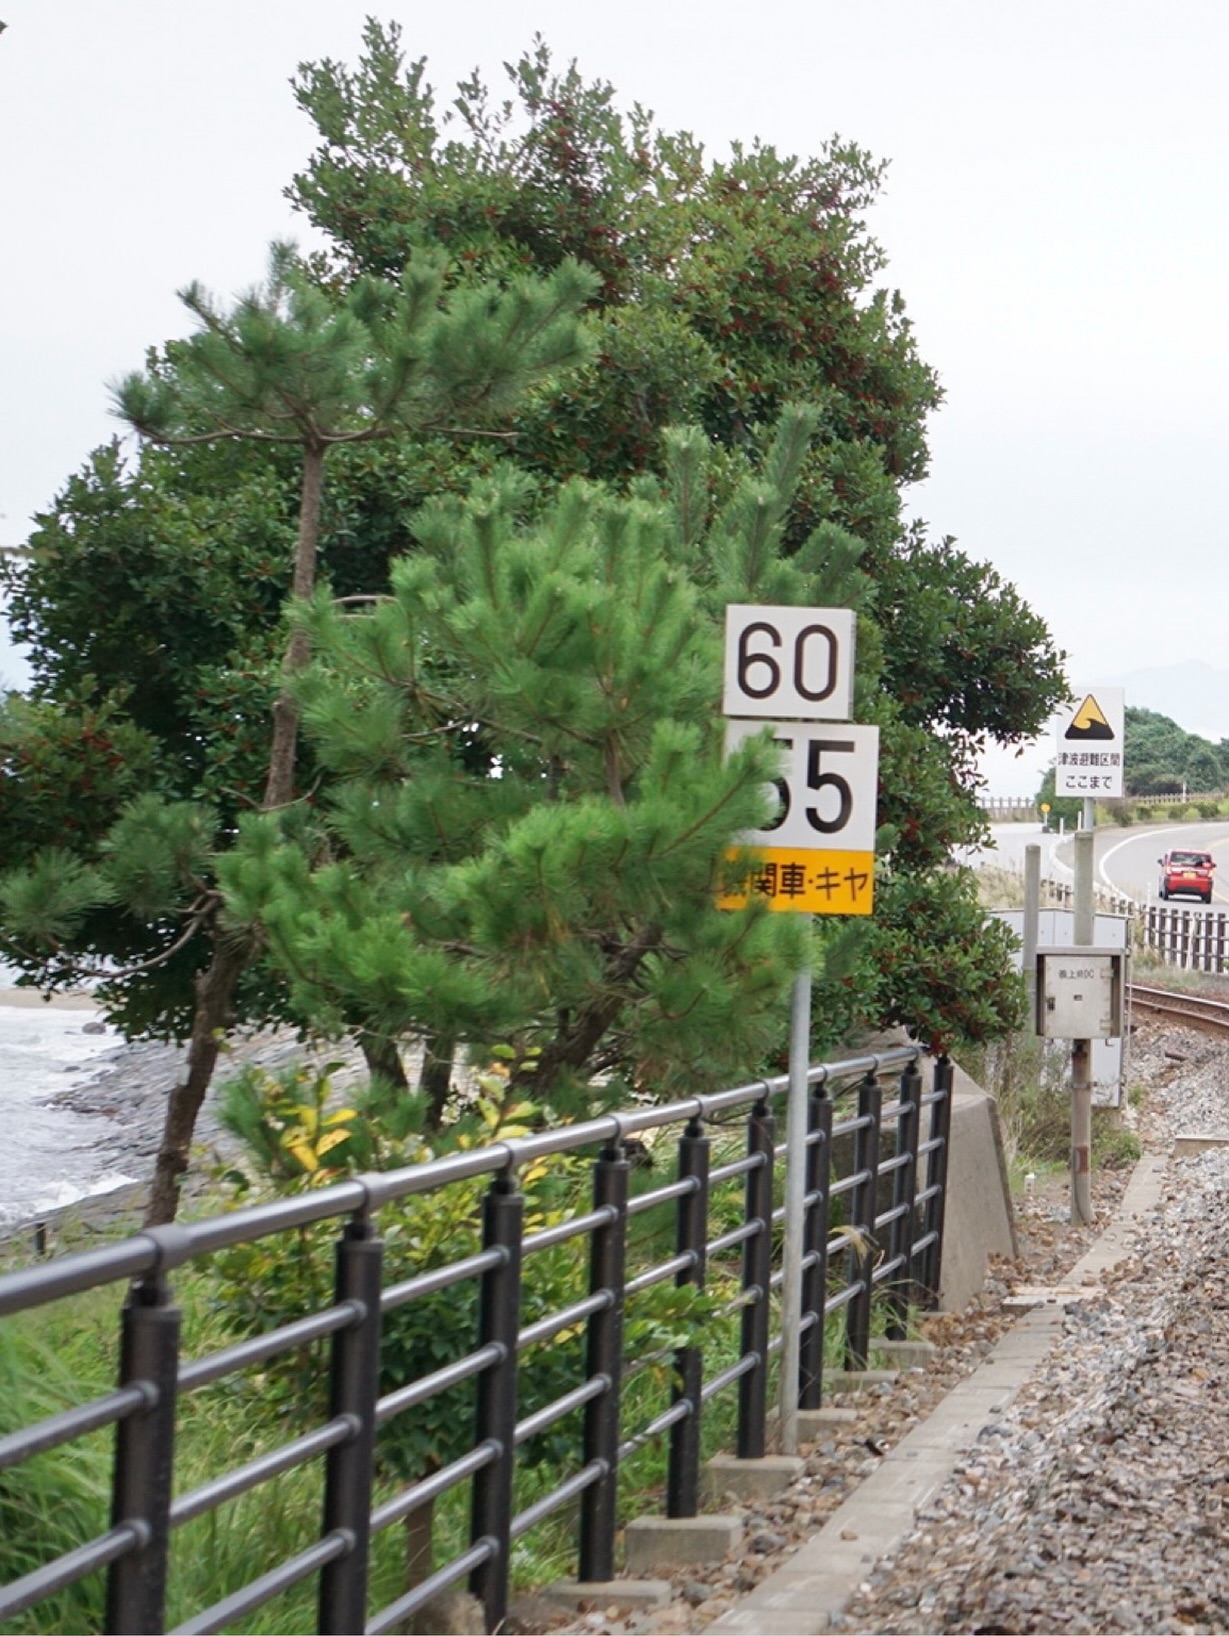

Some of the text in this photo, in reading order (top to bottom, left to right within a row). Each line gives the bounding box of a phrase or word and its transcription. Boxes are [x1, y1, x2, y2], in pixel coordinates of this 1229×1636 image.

[737, 621, 838, 702] 60
[1065, 775, 1113, 790] ここまで
[724, 861, 869, 902] 関車・キヤ
